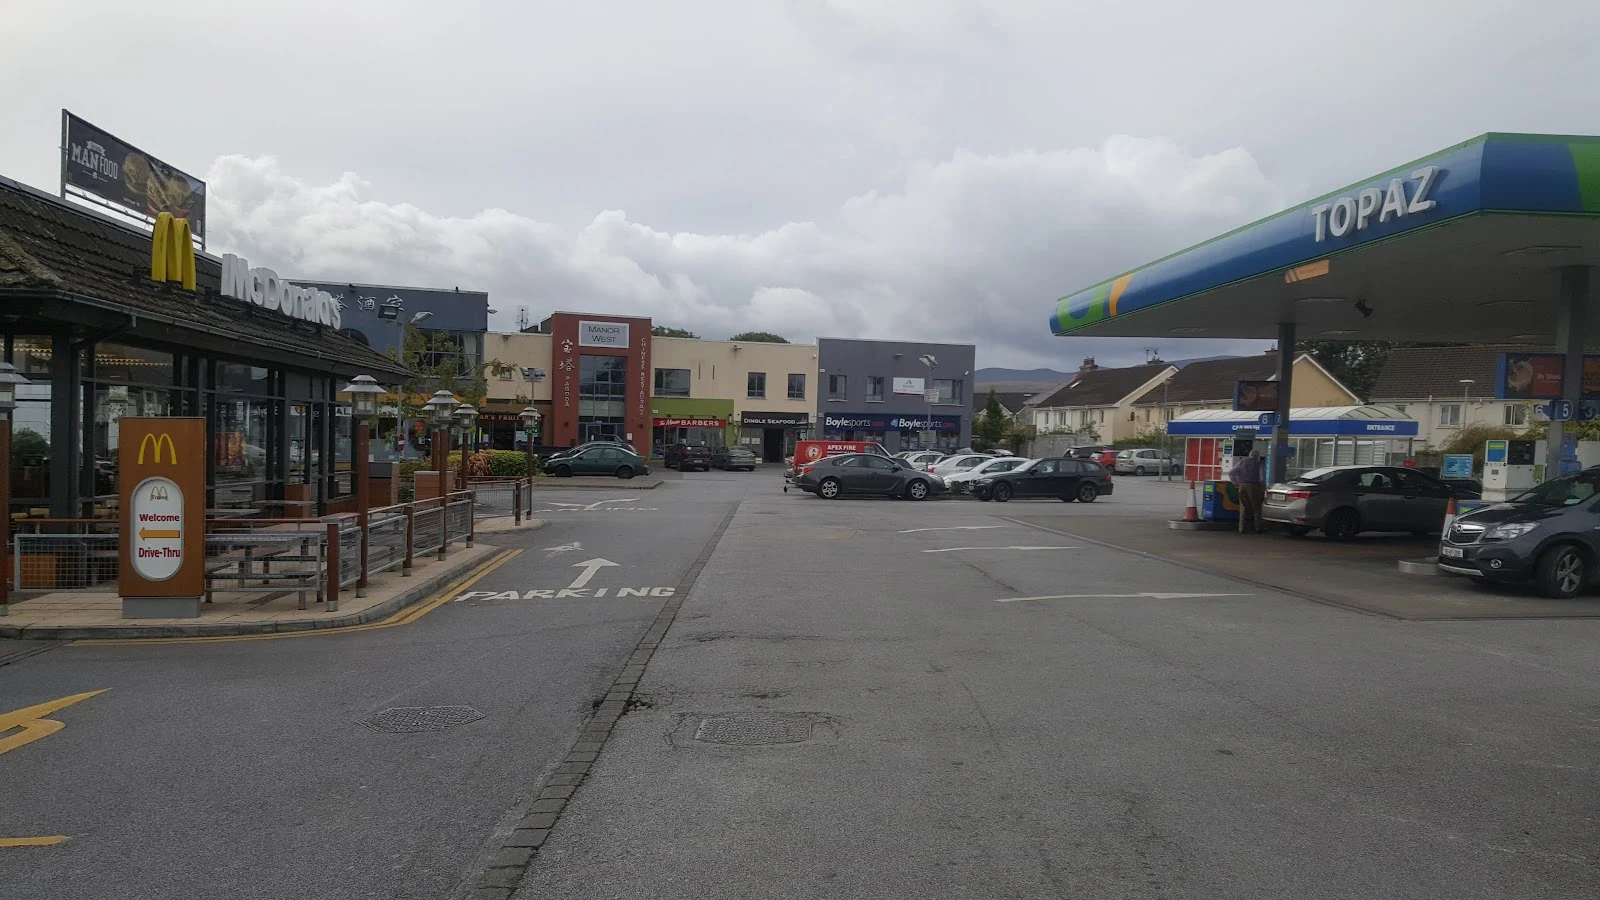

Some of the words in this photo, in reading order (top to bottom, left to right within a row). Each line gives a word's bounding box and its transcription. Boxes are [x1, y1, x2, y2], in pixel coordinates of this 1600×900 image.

[72, 142, 99, 172] MAN
[99, 156, 118, 179] FOOD
[1311, 166, 1439, 242] TOPAZ
[588, 325, 620, 335] MANOR
[591, 334, 617, 343] WEST
[1562, 403, 1569, 417] 5
[1262, 414, 1268, 424] 8
[139, 513, 180, 522] Welcome
[138, 547, 181, 558] Drive-Thru
[454, 586, 677, 601] PARKING
